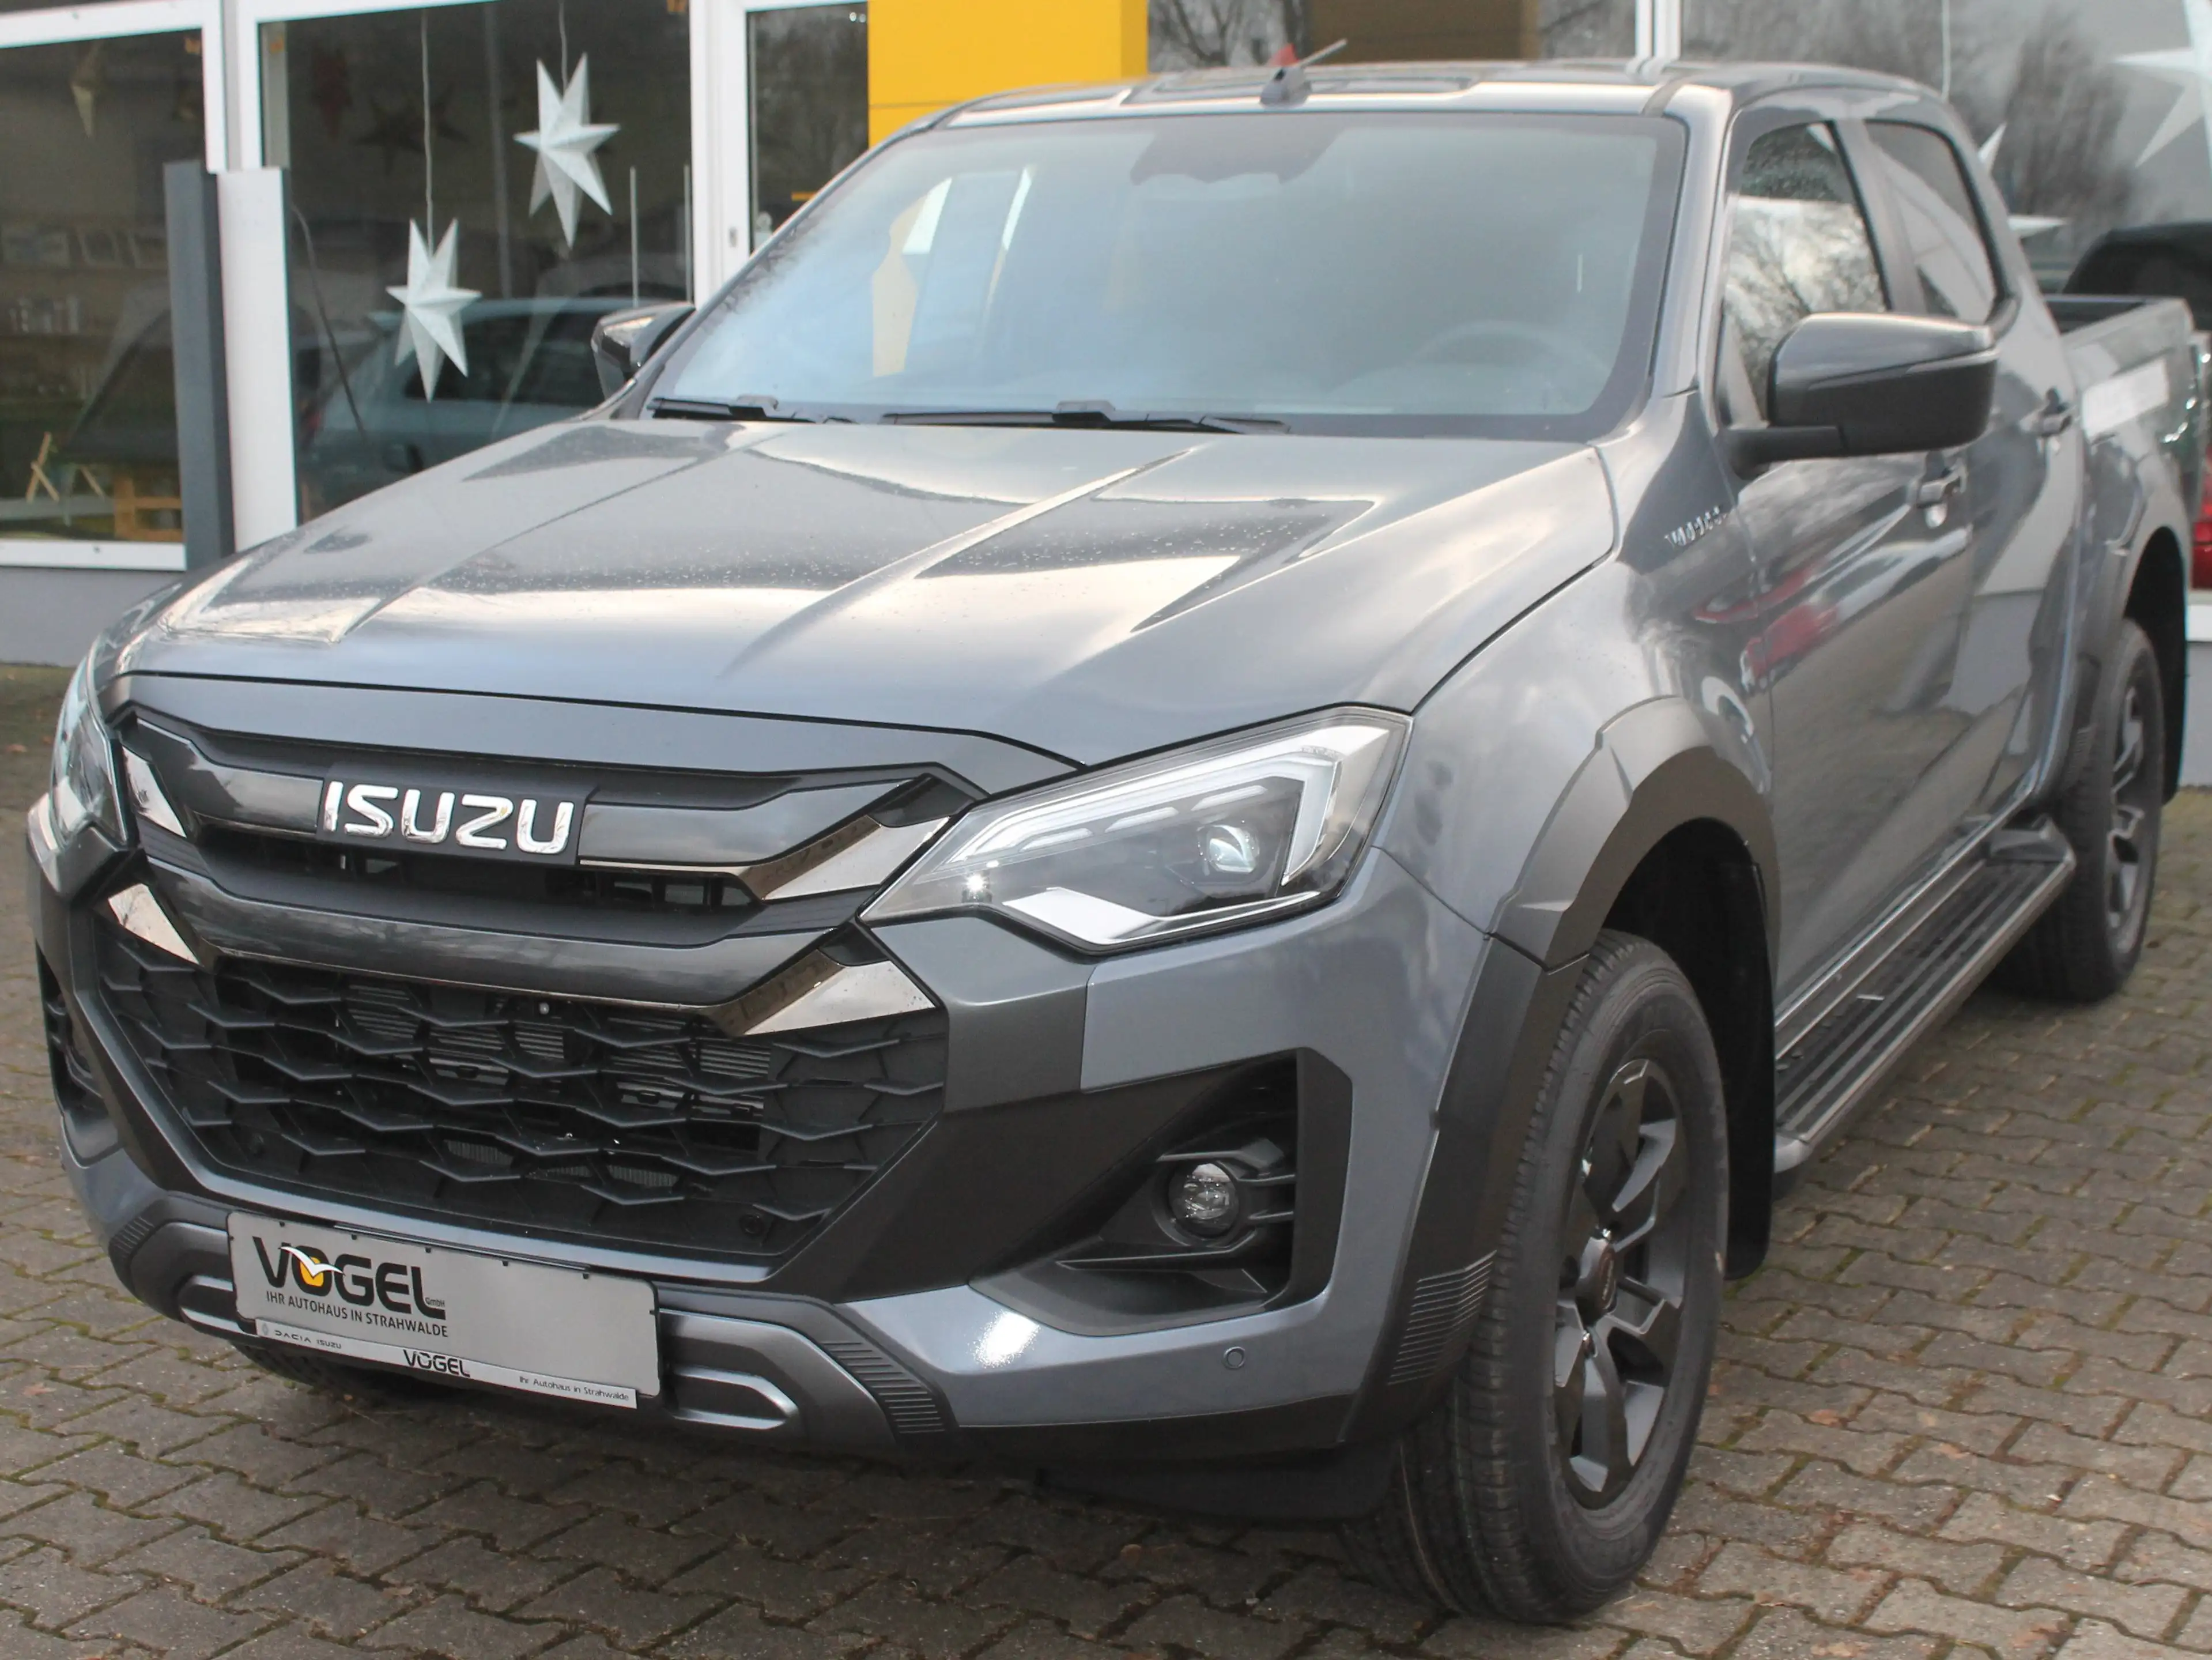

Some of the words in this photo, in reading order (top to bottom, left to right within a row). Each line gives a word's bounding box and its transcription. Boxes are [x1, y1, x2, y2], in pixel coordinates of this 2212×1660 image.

[323, 781, 574, 854] ISUZU
[252, 1236, 447, 1321] VOGEL
[266, 1291, 285, 1305] IHR
[288, 1295, 348, 1319] AUTOHAUS
[351, 1309, 363, 1322] IN
[365, 1312, 448, 1338] STRAHWALDE
[425, 1297, 446, 1307] GmbH
[274, 1330, 311, 1343] DACIA
[316, 1340, 341, 1349] ISUZU
[403, 1349, 470, 1377] VOGEL
[533, 1379, 571, 1392] Autohaus
[584, 1387, 629, 1401] Strahwalde
